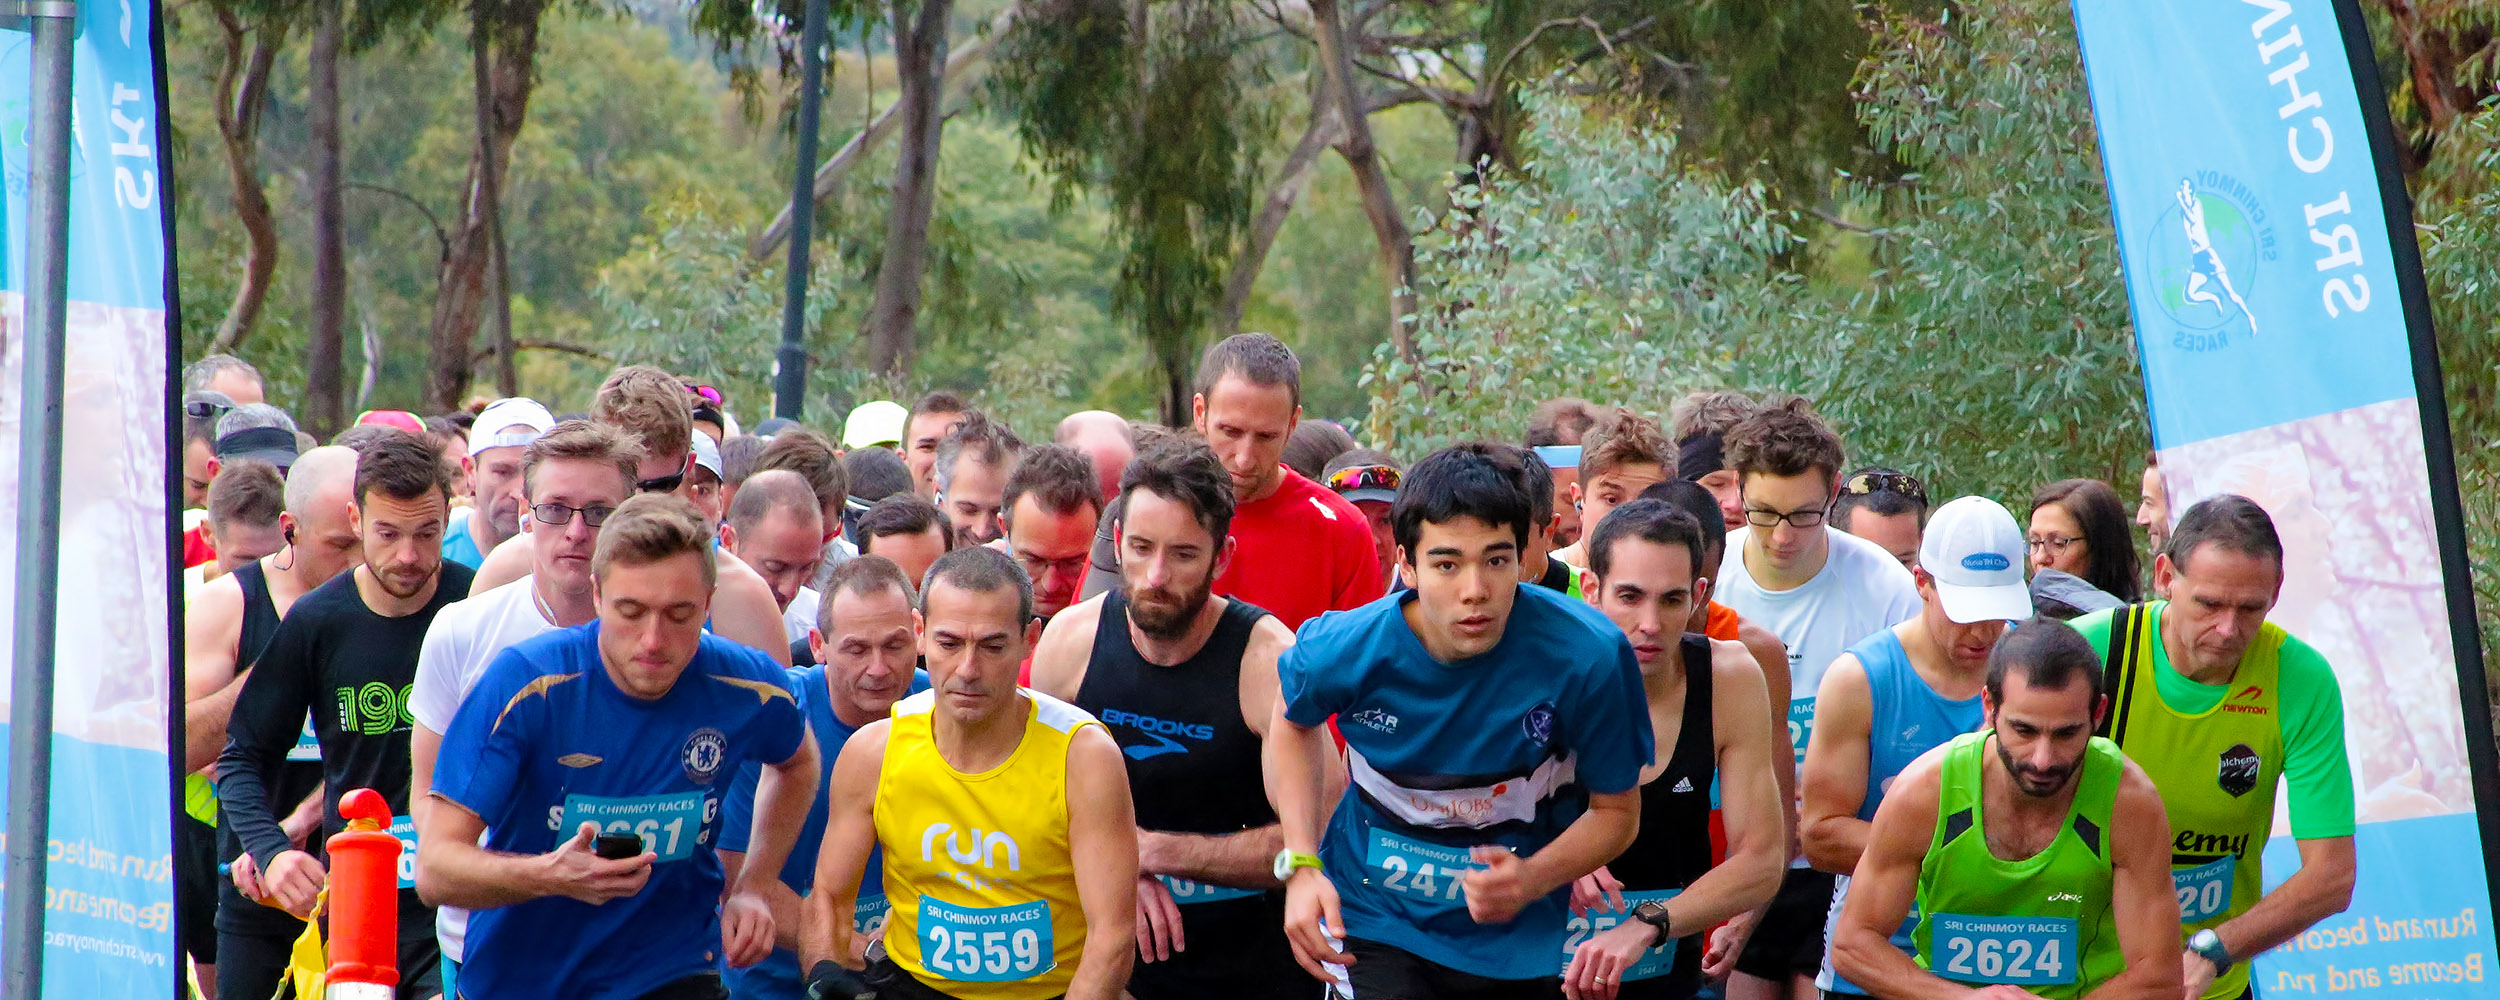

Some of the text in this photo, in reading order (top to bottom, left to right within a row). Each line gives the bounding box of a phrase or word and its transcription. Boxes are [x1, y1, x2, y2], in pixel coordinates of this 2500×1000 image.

[1101, 708, 1215, 740] BROOKS
[576, 802, 596, 815] SRI
[598, 803, 655, 815] CHINMOY
[657, 799, 695, 813] RACES
[921, 822, 1020, 871] run
[1380, 836, 1400, 850] SRI
[1401, 842, 1459, 863] CHINMOY
[2172, 830, 2250, 861] emy
[1382, 855, 1466, 900] 247
[926, 905, 1041, 926] SRI CHINMOY RACES
[1944, 920, 2068, 934] SRI CHINMOY RACES
[929, 925, 1040, 975] 2559
[1947, 936, 2063, 978] 2624
